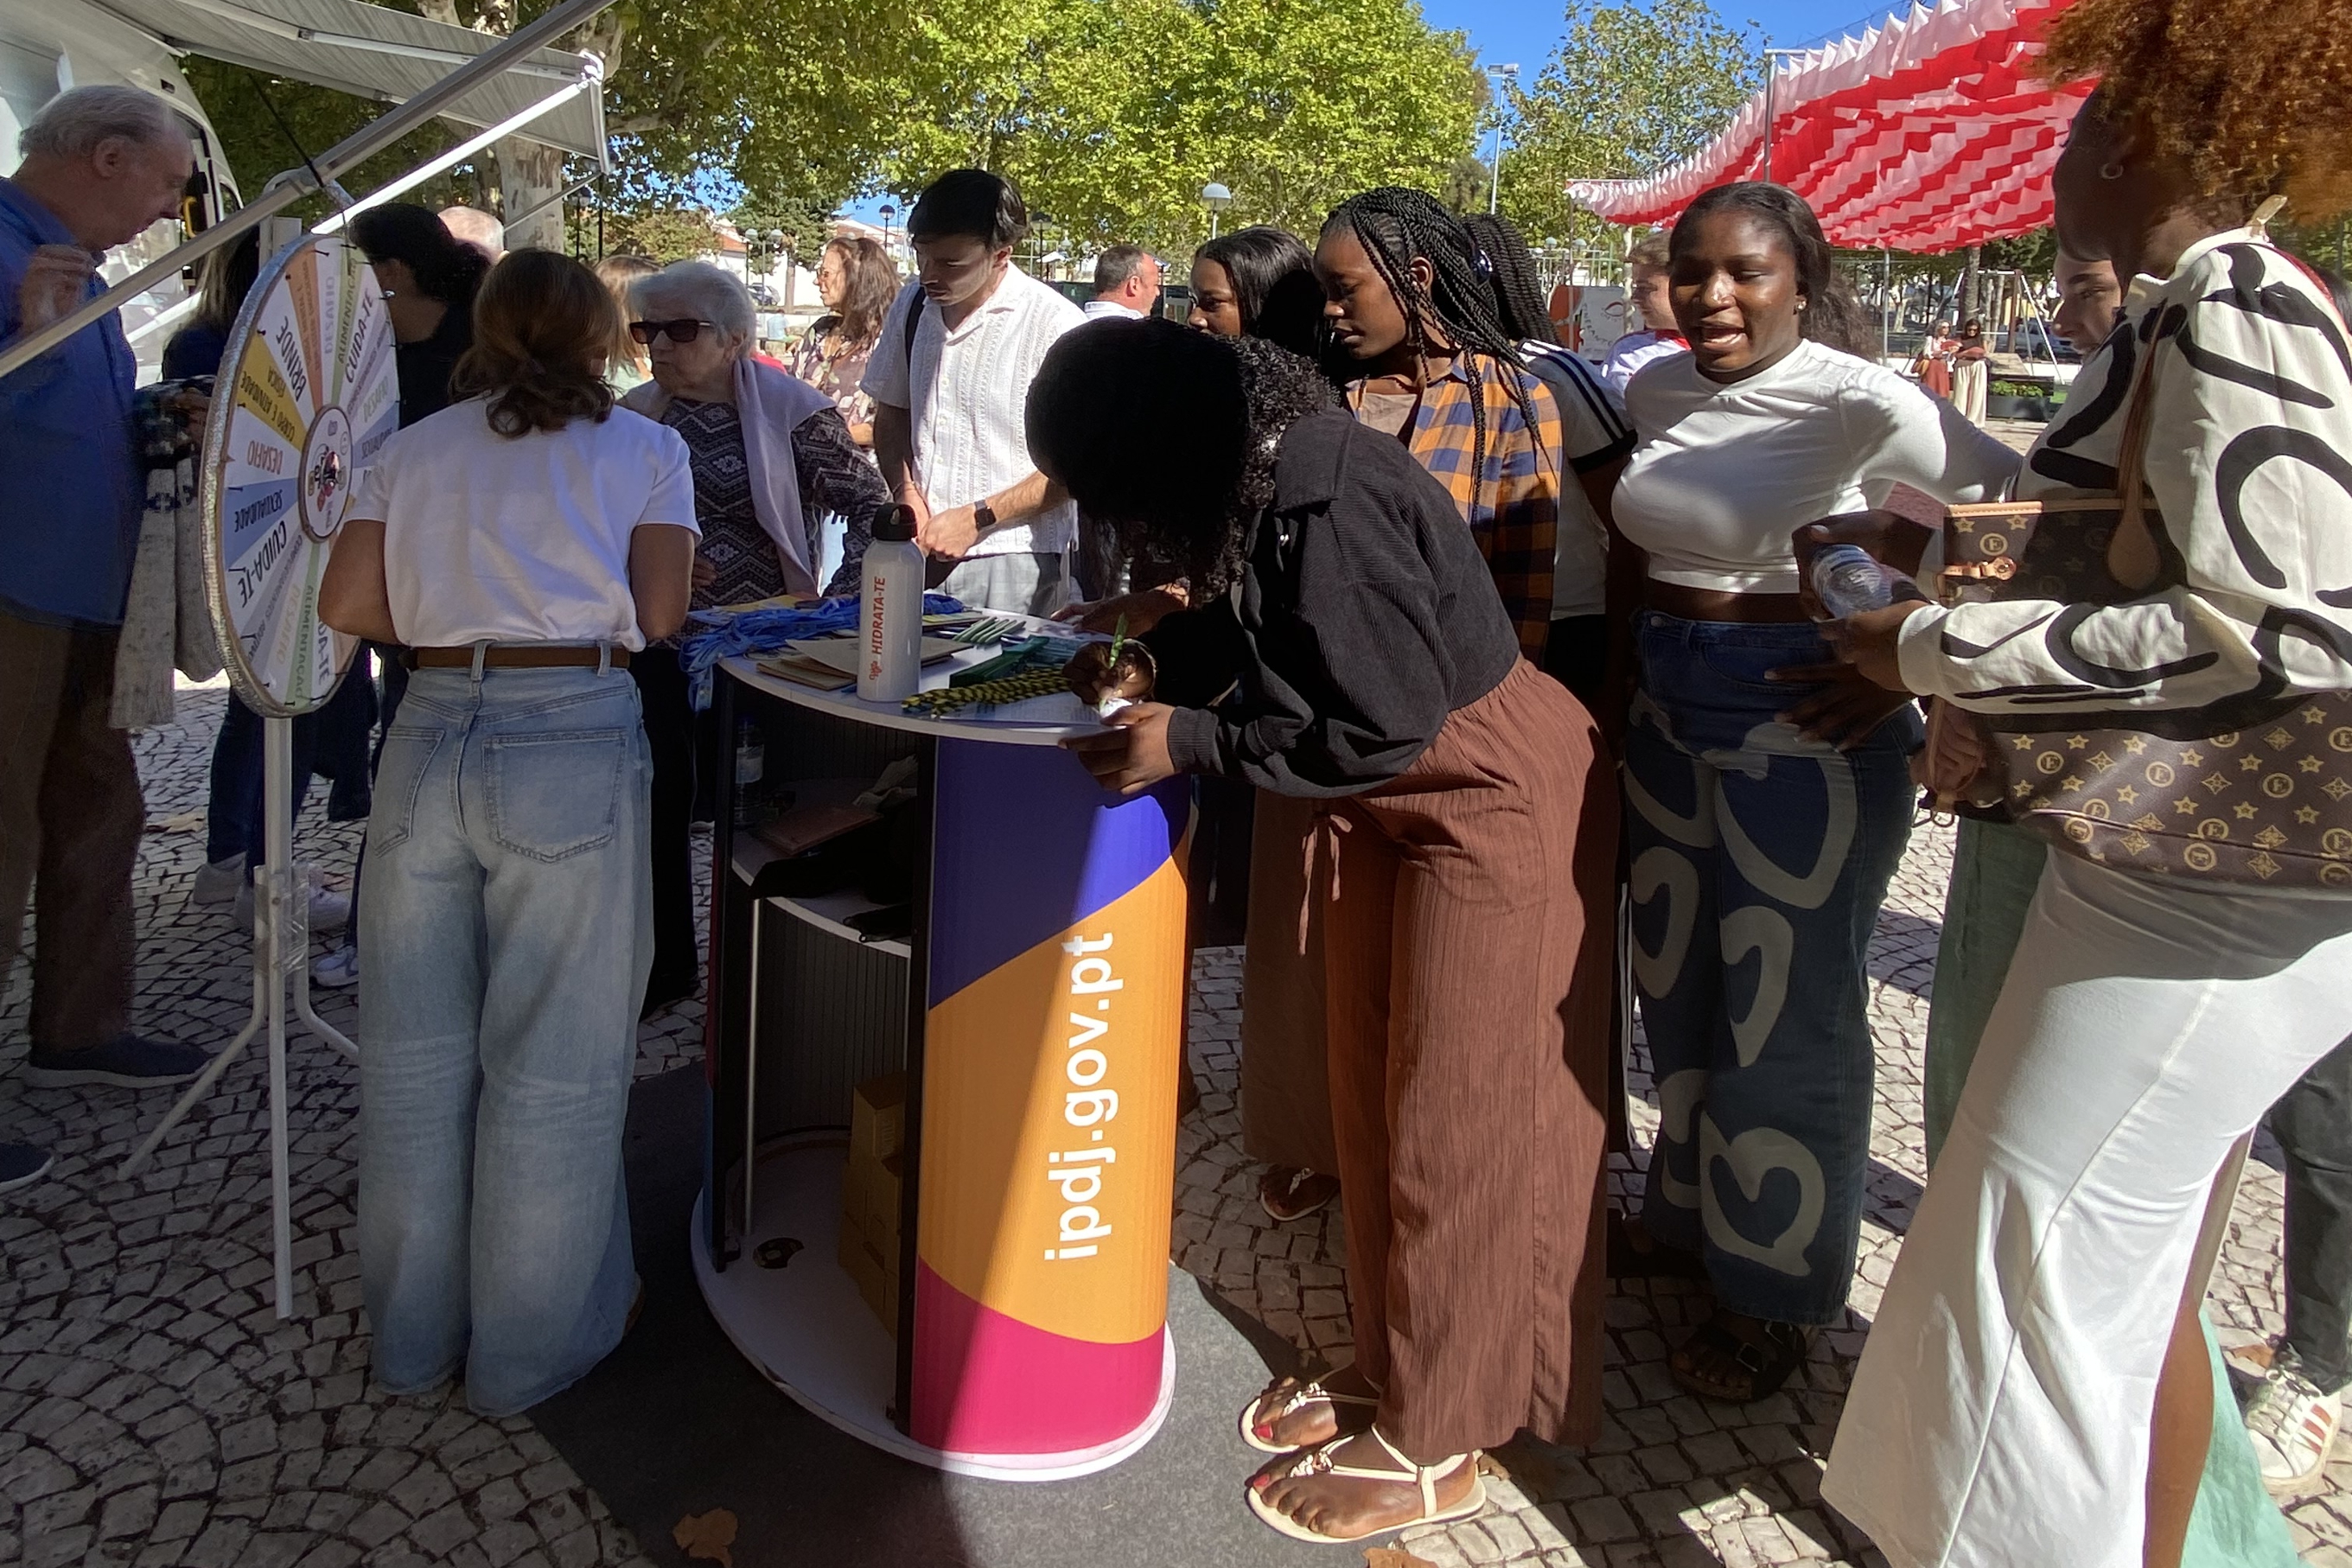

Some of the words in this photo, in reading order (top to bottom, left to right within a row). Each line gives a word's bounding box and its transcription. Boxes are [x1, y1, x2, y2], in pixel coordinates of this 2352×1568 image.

[324, 276, 335, 355] DESAFIO
[345, 287, 373, 383] CUIDA-TE
[276, 316, 307, 402] BRINDE
[247, 440, 284, 475] DESAFIO
[234, 489, 283, 532] SEXUALIDADE
[238, 520, 287, 609] CUIDA-TE
[279, 583, 301, 665] DESAFIO
[871, 576, 885, 654] HIDRATA-TE
[1044, 932, 1124, 1261] ipdj.gov.pt
